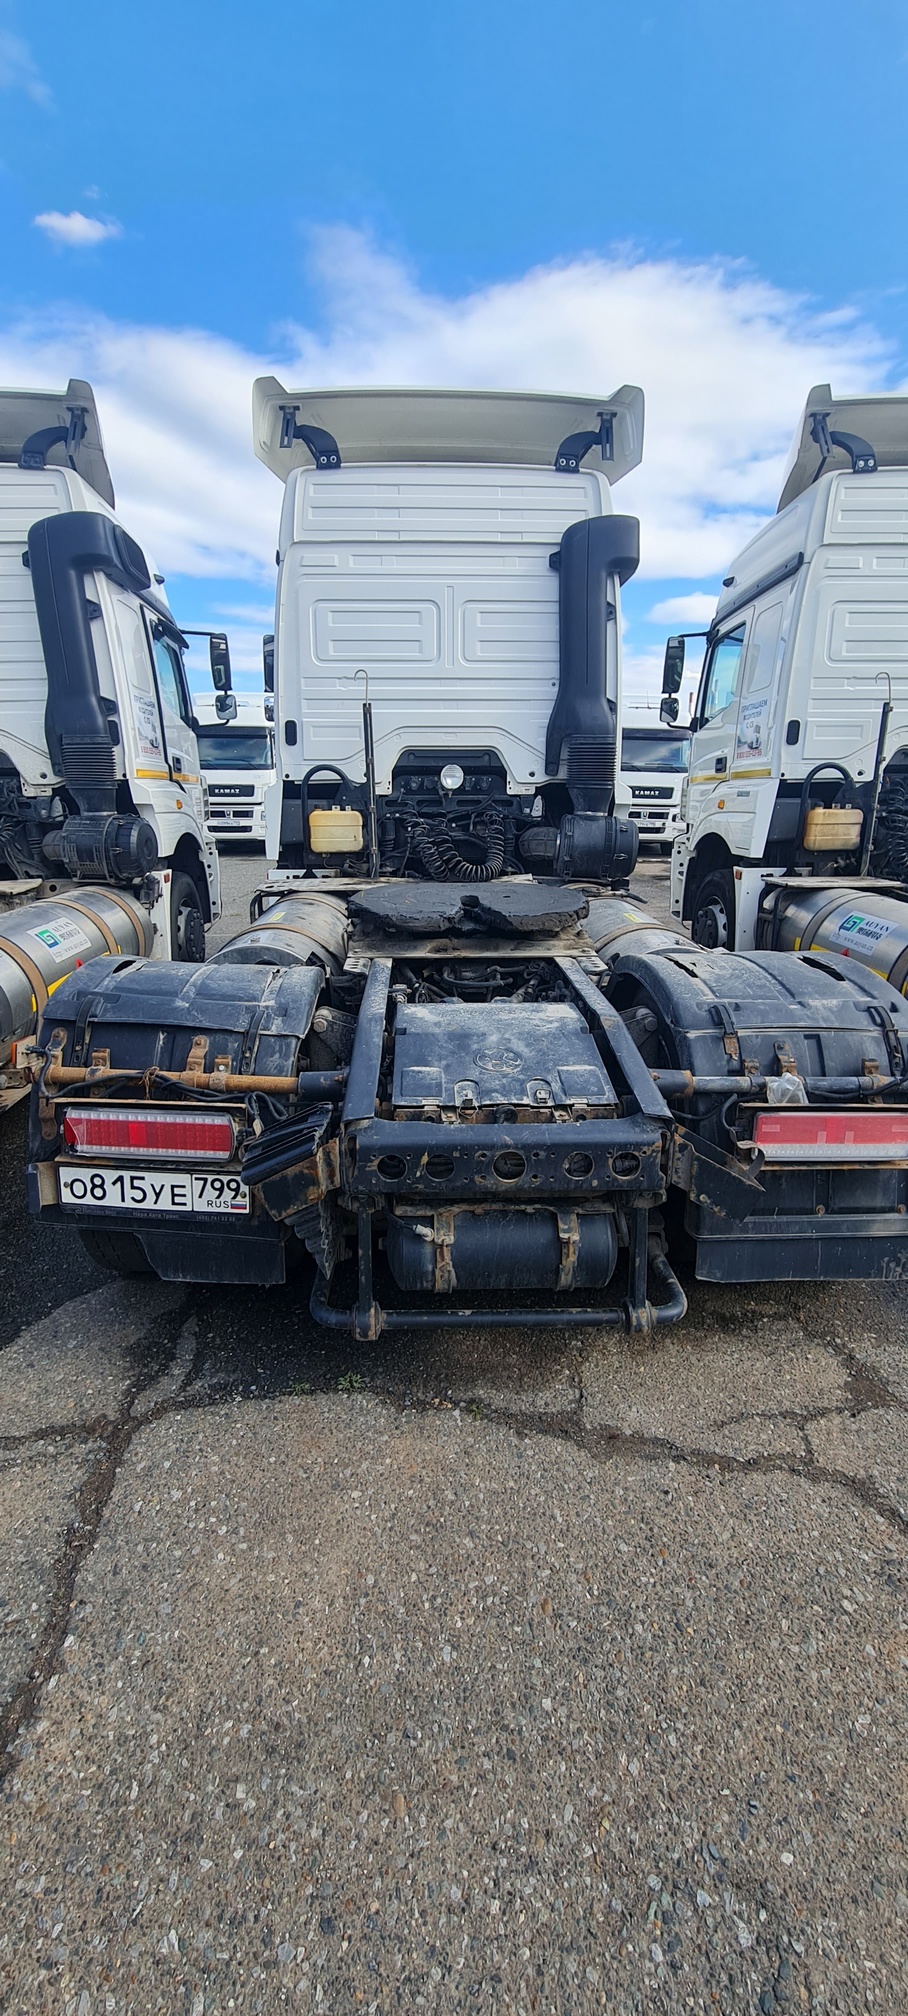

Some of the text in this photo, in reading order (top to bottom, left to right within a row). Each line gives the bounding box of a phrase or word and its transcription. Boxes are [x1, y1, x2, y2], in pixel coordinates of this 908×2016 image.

[865, 920, 891, 932] AUYAN
[194, 1176, 240, 1200] 799
[206, 1200, 230, 1209] RUS
